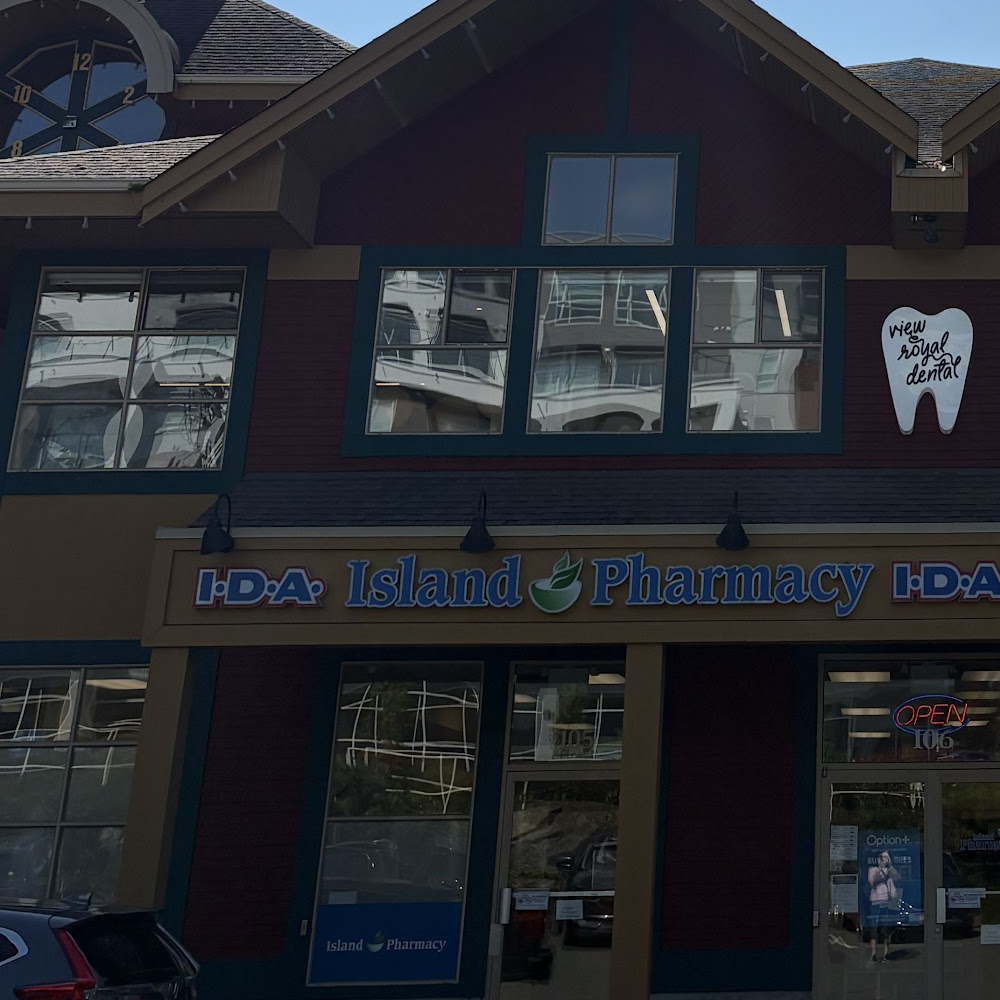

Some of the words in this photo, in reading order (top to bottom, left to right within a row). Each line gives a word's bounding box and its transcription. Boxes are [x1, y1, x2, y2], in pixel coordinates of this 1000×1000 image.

[72, 53, 92, 71] 12
[13, 85, 32, 104] 10
[122, 86, 135, 104] 2
[889, 320, 926, 339] view
[897, 331, 949, 366] royal
[906, 356, 961, 385] dental
[344, 554, 523, 607] Island
[590, 552, 874, 617] Pharmacy
[895, 703, 968, 726] OPEN
[913, 728, 954, 750] 106
[866, 834, 910, 847] Option+
[326, 939, 363, 952] Island
[386, 938, 447, 952] Pharmacy
